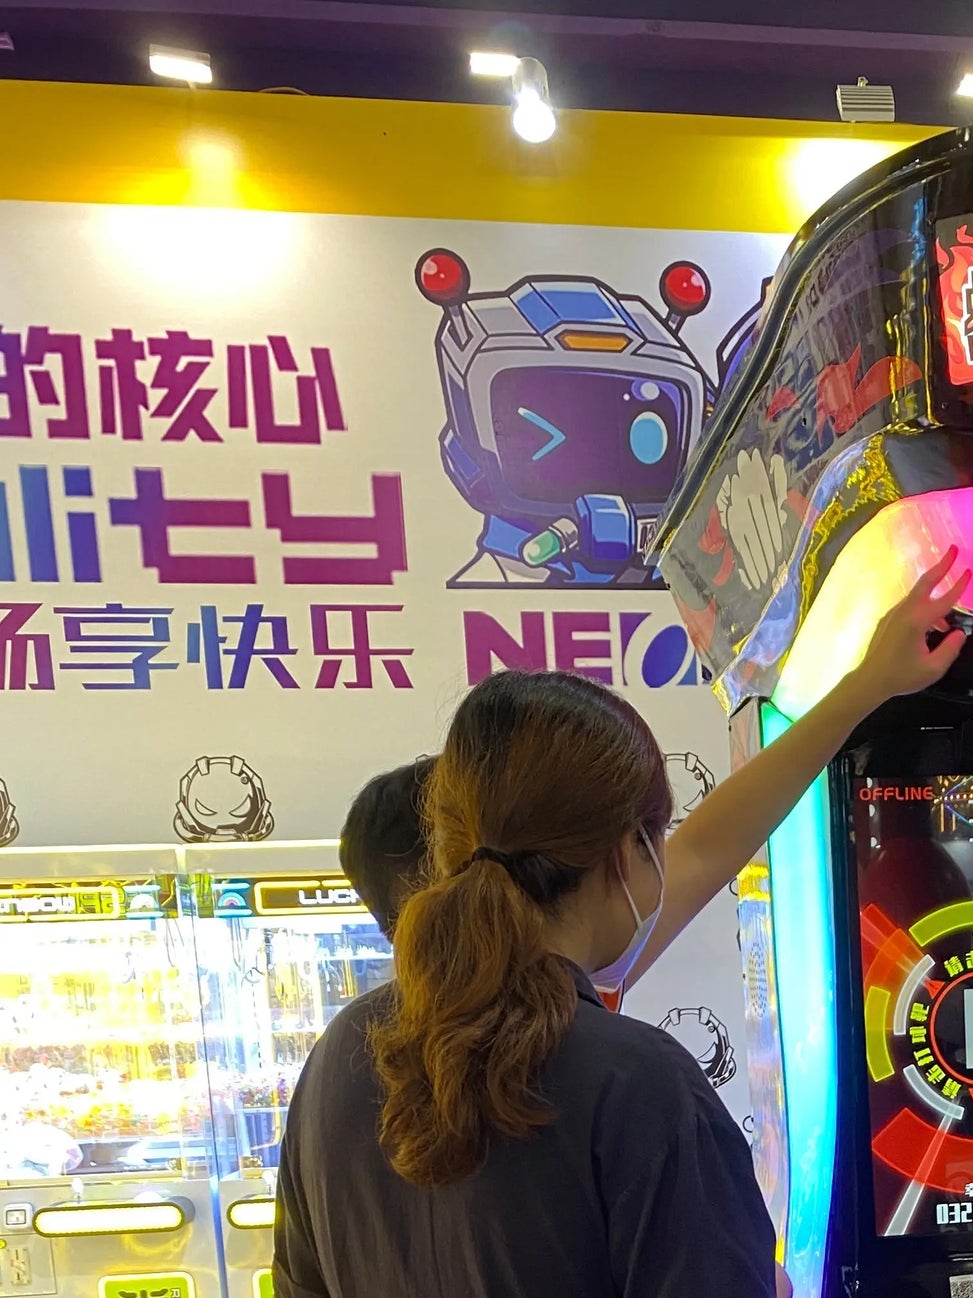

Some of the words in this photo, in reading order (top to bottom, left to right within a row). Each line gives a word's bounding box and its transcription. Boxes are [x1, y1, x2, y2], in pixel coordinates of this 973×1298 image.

[0, 325, 347, 444] 的核心
[0, 464, 407, 585] lity
[859, 786, 934, 801] OFFLINE
